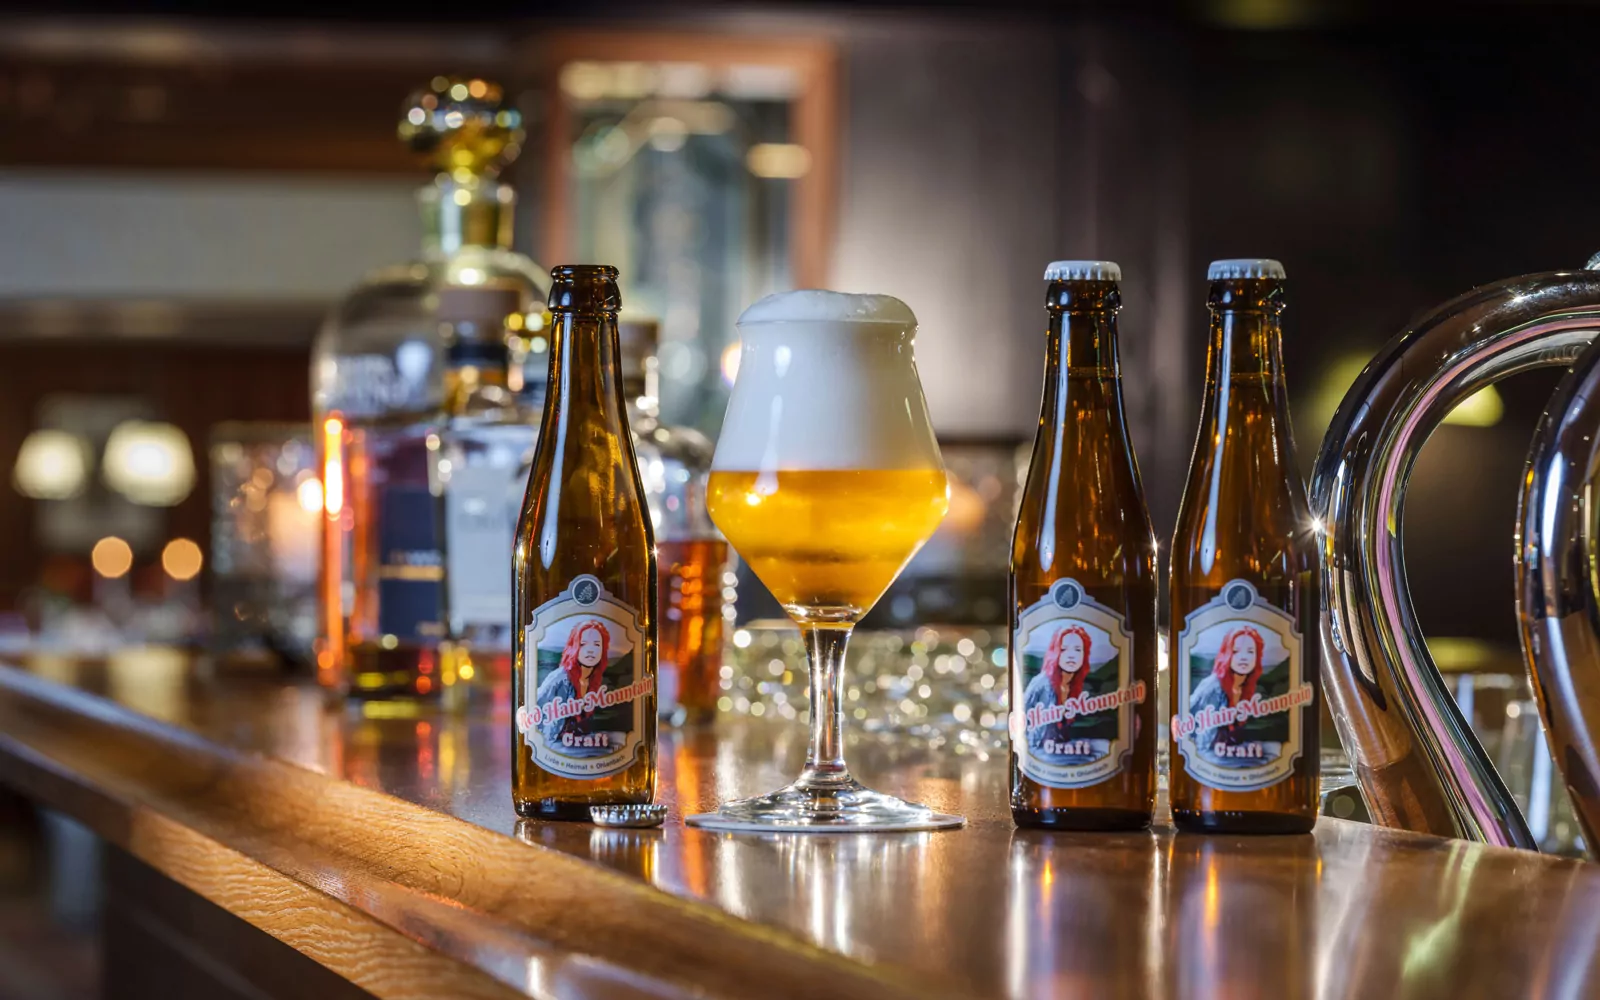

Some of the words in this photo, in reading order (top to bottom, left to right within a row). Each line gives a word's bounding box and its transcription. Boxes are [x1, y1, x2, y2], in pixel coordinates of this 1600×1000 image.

[517, 705, 542, 732] Red
[543, 697, 582, 725] Hair
[584, 677, 653, 712] Mountain
[1027, 702, 1064, 732] Hair
[1065, 680, 1146, 719] Mountain
[1171, 713, 1195, 742] Red
[1195, 704, 1236, 734] Hair
[1236, 682, 1313, 721] Mountain
[562, 732, 609, 747] Craft
[1043, 740, 1091, 755] Craft
[1213, 742, 1263, 758] Craft
